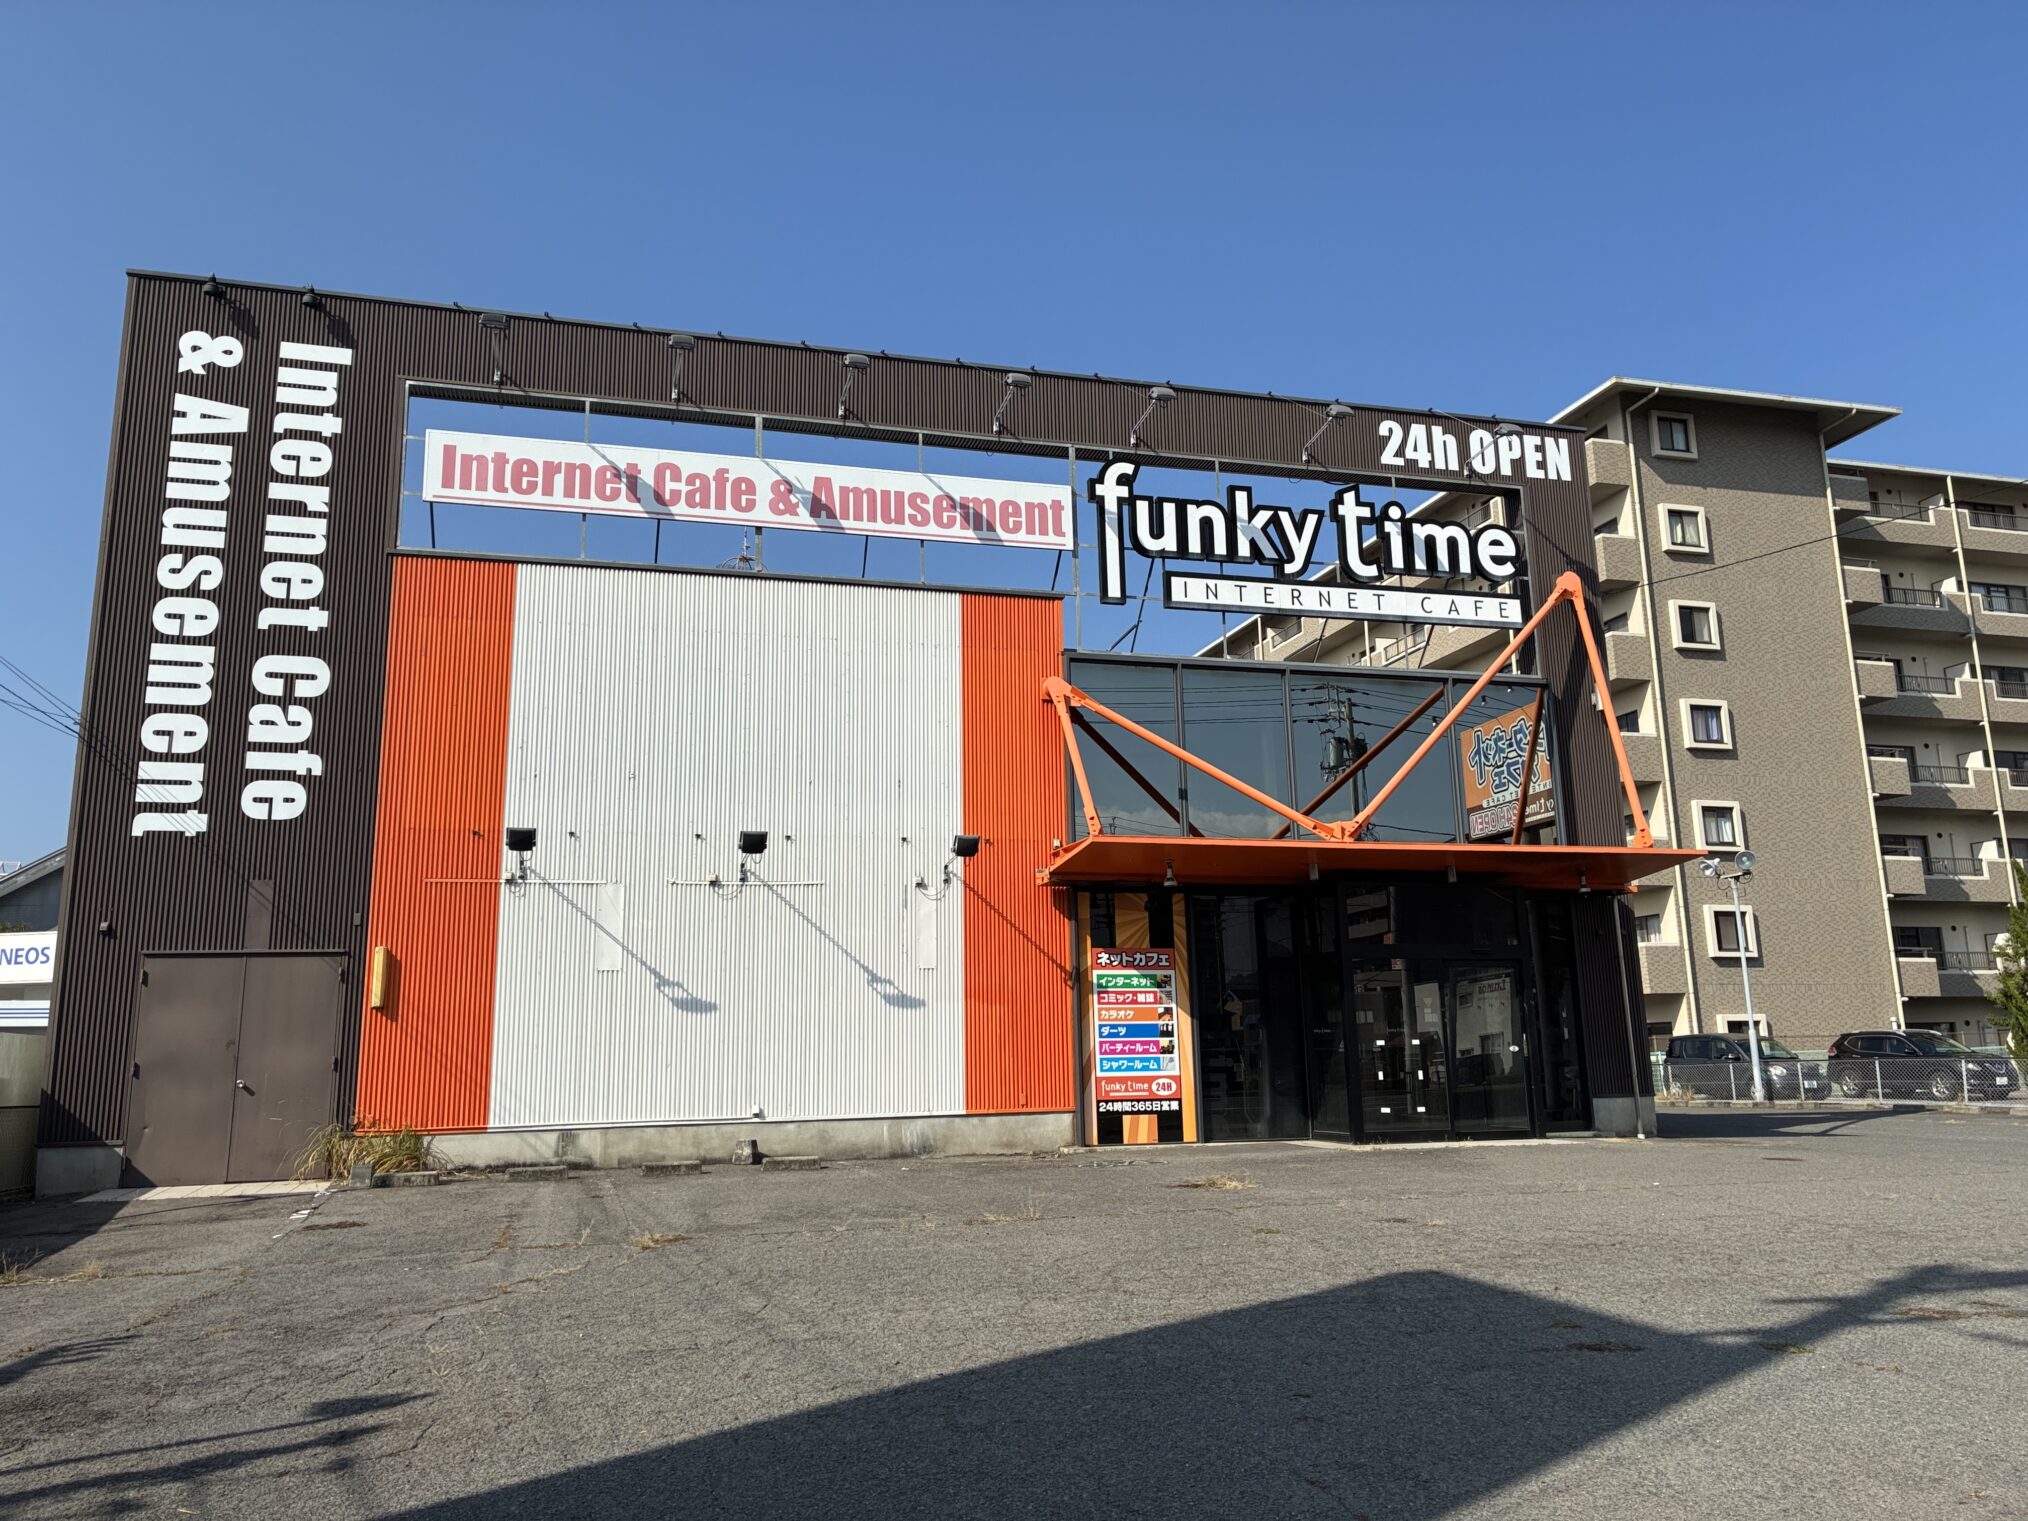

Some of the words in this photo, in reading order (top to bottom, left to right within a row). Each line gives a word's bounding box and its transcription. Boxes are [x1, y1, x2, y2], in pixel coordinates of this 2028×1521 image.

[177, 329, 244, 375] &
[1378, 419, 1460, 472] 24h
[1468, 428, 1572, 482] OPEN
[257, 340, 353, 632] Internet
[441, 443, 642, 502] Internet
[652, 460, 757, 515] Cafe
[768, 477, 801, 518] &
[809, 475, 1067, 539] Amusement
[1093, 460, 1325, 600] funky
[1337, 488, 1519, 579] time
[131, 392, 250, 837] Amusement
[1182, 579, 1385, 613] INTERNET
[1420, 595, 1511, 620] CAFE
[240, 654, 332, 821] Cafe
[1097, 952, 1171, 967] ネットカフェ
[1099, 976, 1154, 987] インターネット
[1100, 1009, 1134, 1019] カラオケ
[1100, 1026, 1127, 1036] ダーツ
[1102, 1060, 1158, 1070] シャワールーム
[1101, 1080, 1126, 1097] funky
[1127, 1080, 1149, 1092] time
[1155, 1082, 1173, 1092] 24H
